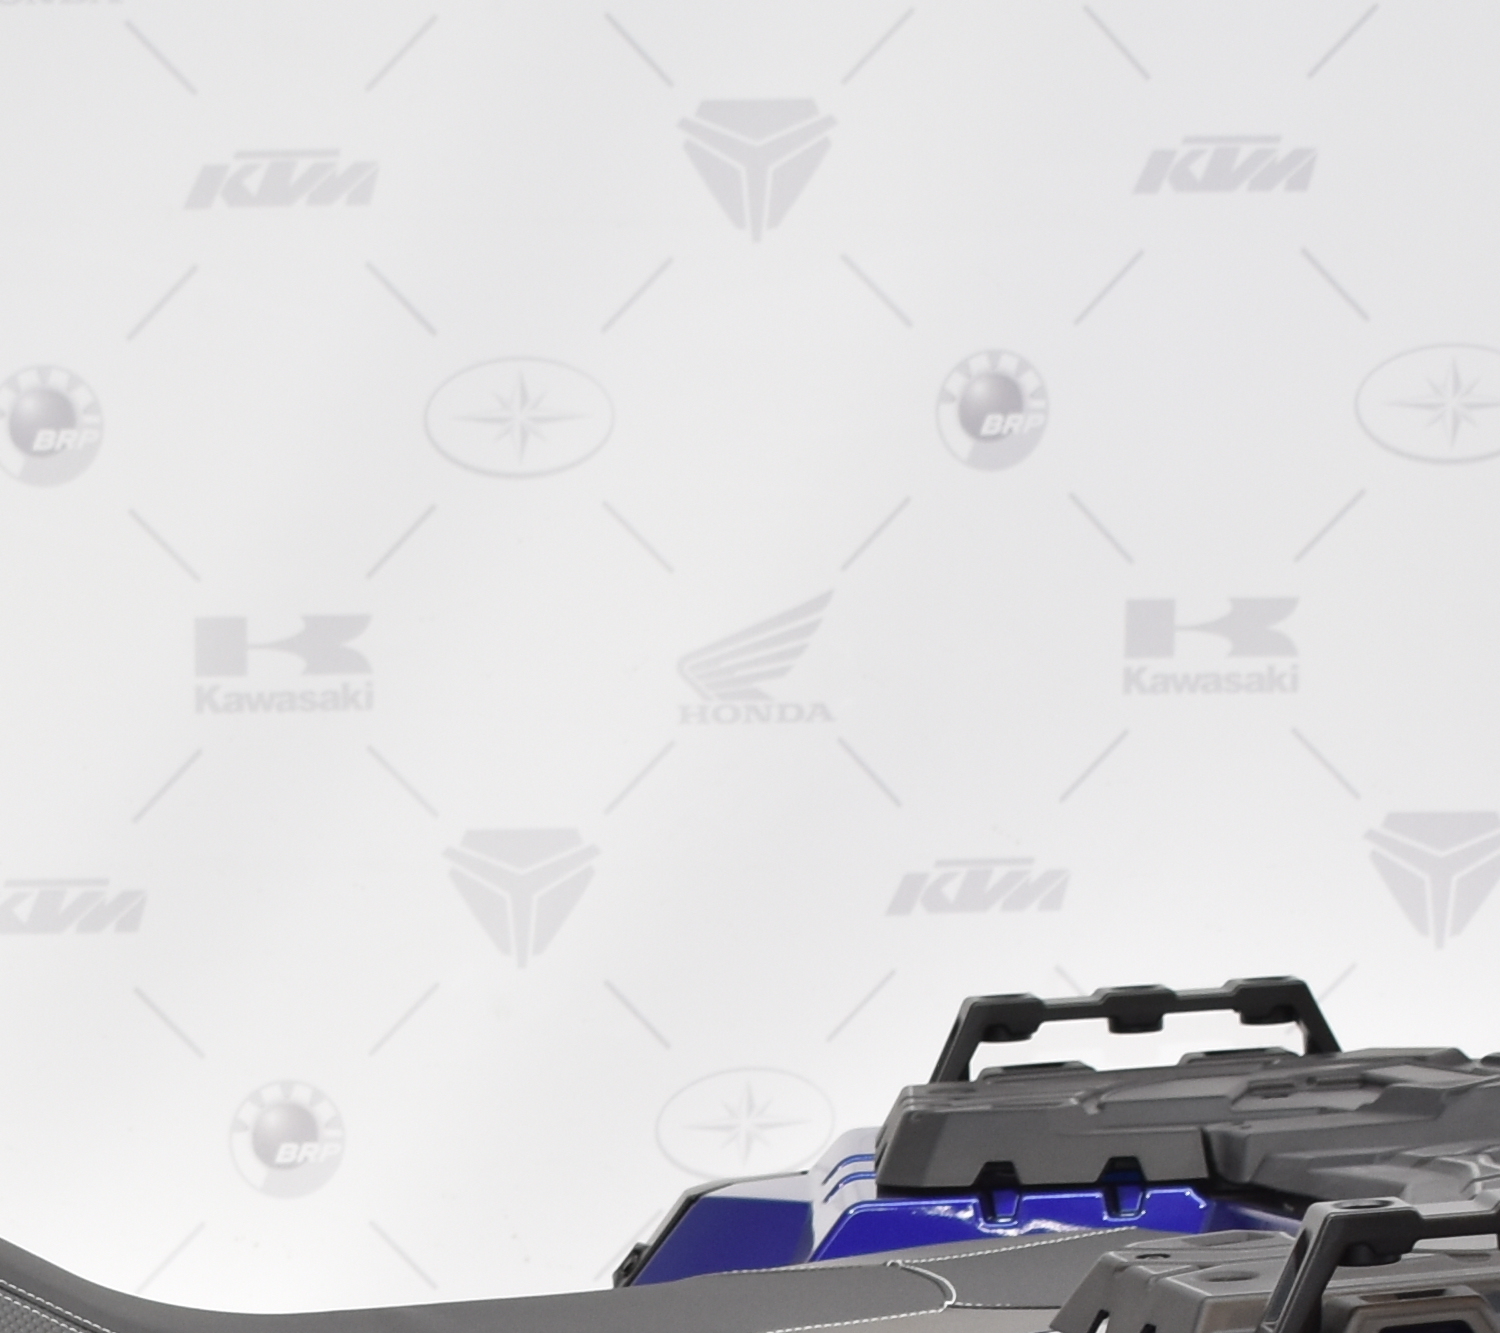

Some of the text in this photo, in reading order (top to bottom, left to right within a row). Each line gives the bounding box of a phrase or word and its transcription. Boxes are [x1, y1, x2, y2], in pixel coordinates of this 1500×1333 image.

[186, 148, 378, 209] KTM
[1135, 134, 1317, 193] KTM
[32, 428, 98, 452] BRP
[978, 413, 1045, 436] BRP
[1120, 665, 1302, 697] Kawasaki
[194, 683, 375, 715] Kawasaki
[678, 700, 835, 725] HONDA
[886, 856, 1069, 916] KTM
[270, 1140, 340, 1165] BRP
